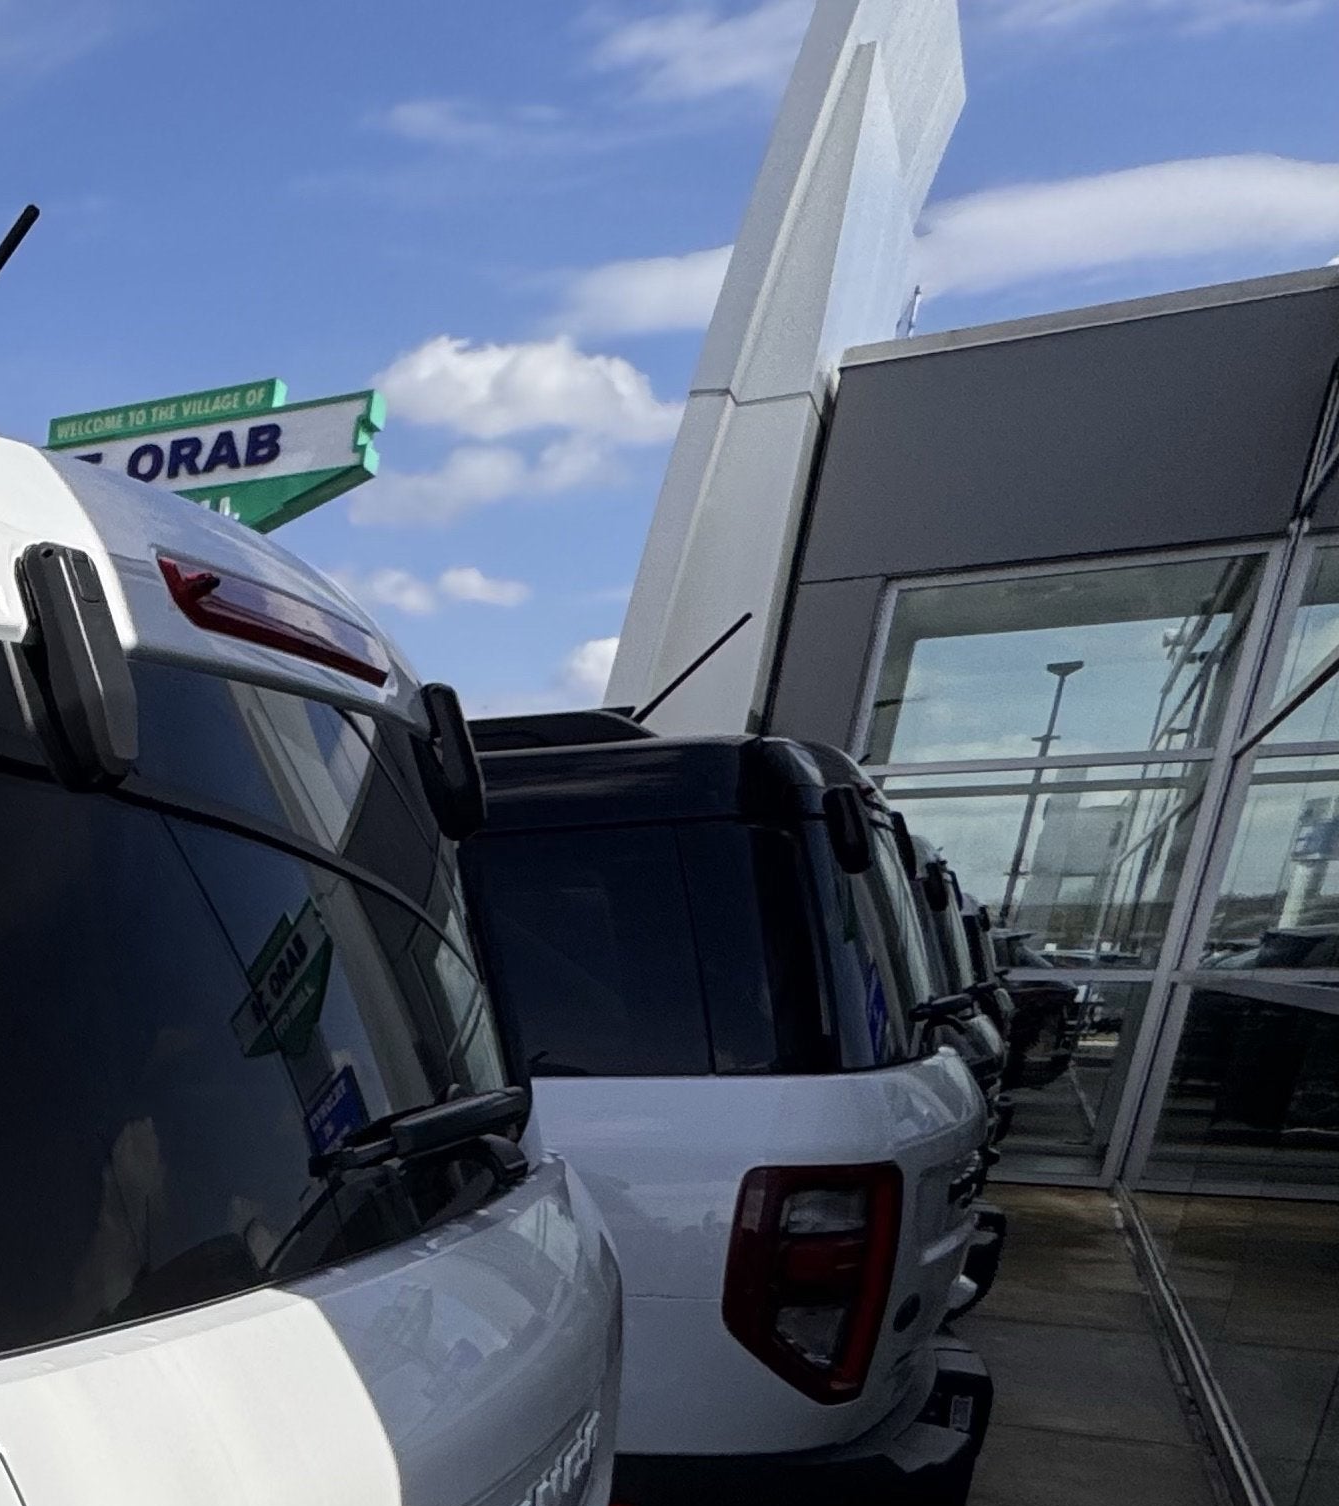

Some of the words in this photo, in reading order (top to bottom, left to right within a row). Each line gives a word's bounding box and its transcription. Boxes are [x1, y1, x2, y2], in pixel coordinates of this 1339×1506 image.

[57, 413, 123, 439] WELCOME
[128, 409, 147, 427] TO
[151, 403, 177, 423] THE
[181, 391, 241, 417] VILLAGE
[245, 387, 266, 406] OF
[126, 422, 282, 483] ORAB
